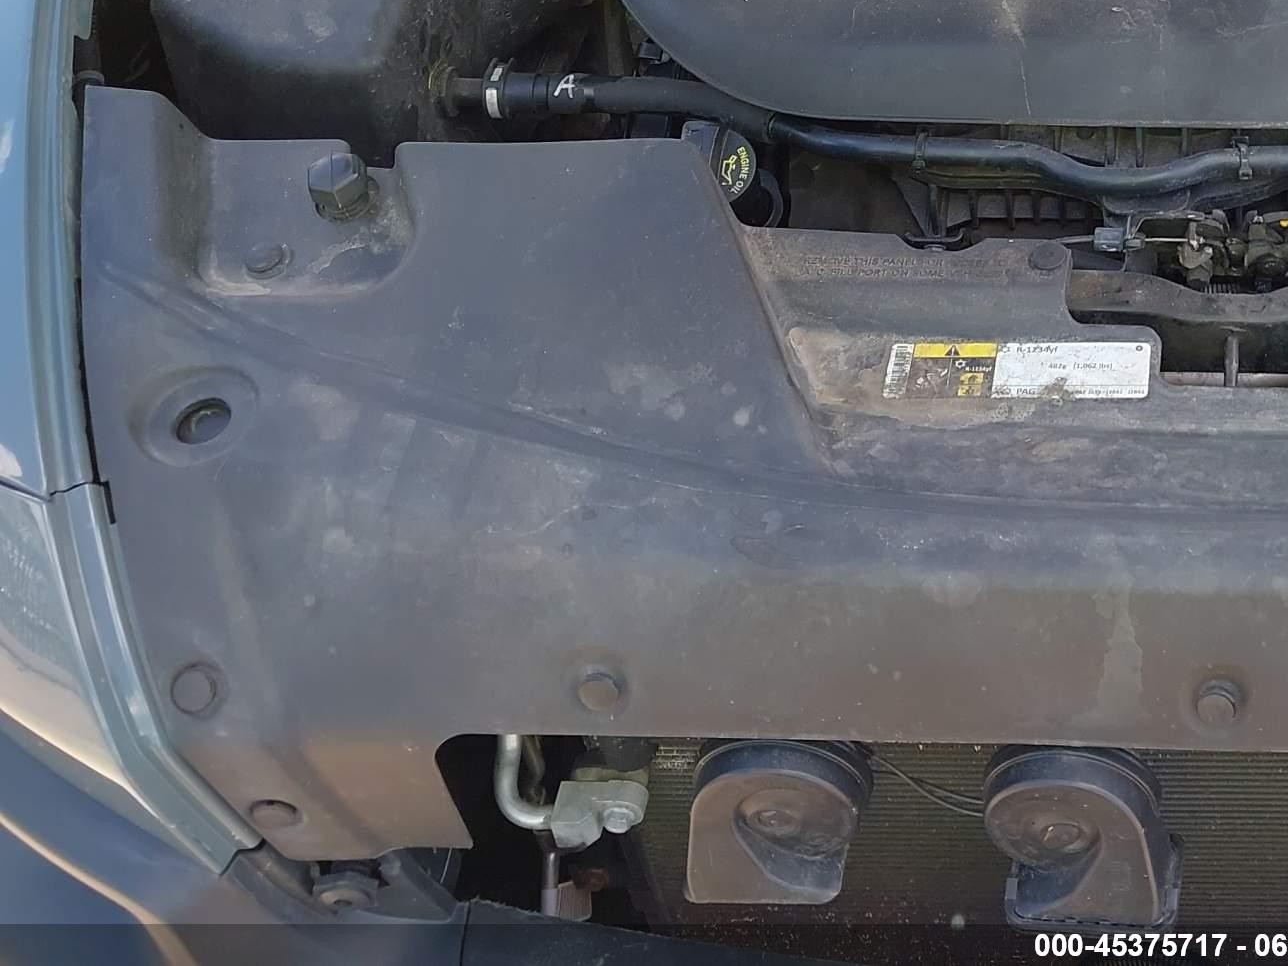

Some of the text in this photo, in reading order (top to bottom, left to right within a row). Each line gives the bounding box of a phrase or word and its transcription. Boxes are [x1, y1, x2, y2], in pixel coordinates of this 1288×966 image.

[553, 74, 575, 98] A
[730, 146, 749, 194] ENGINE OIL
